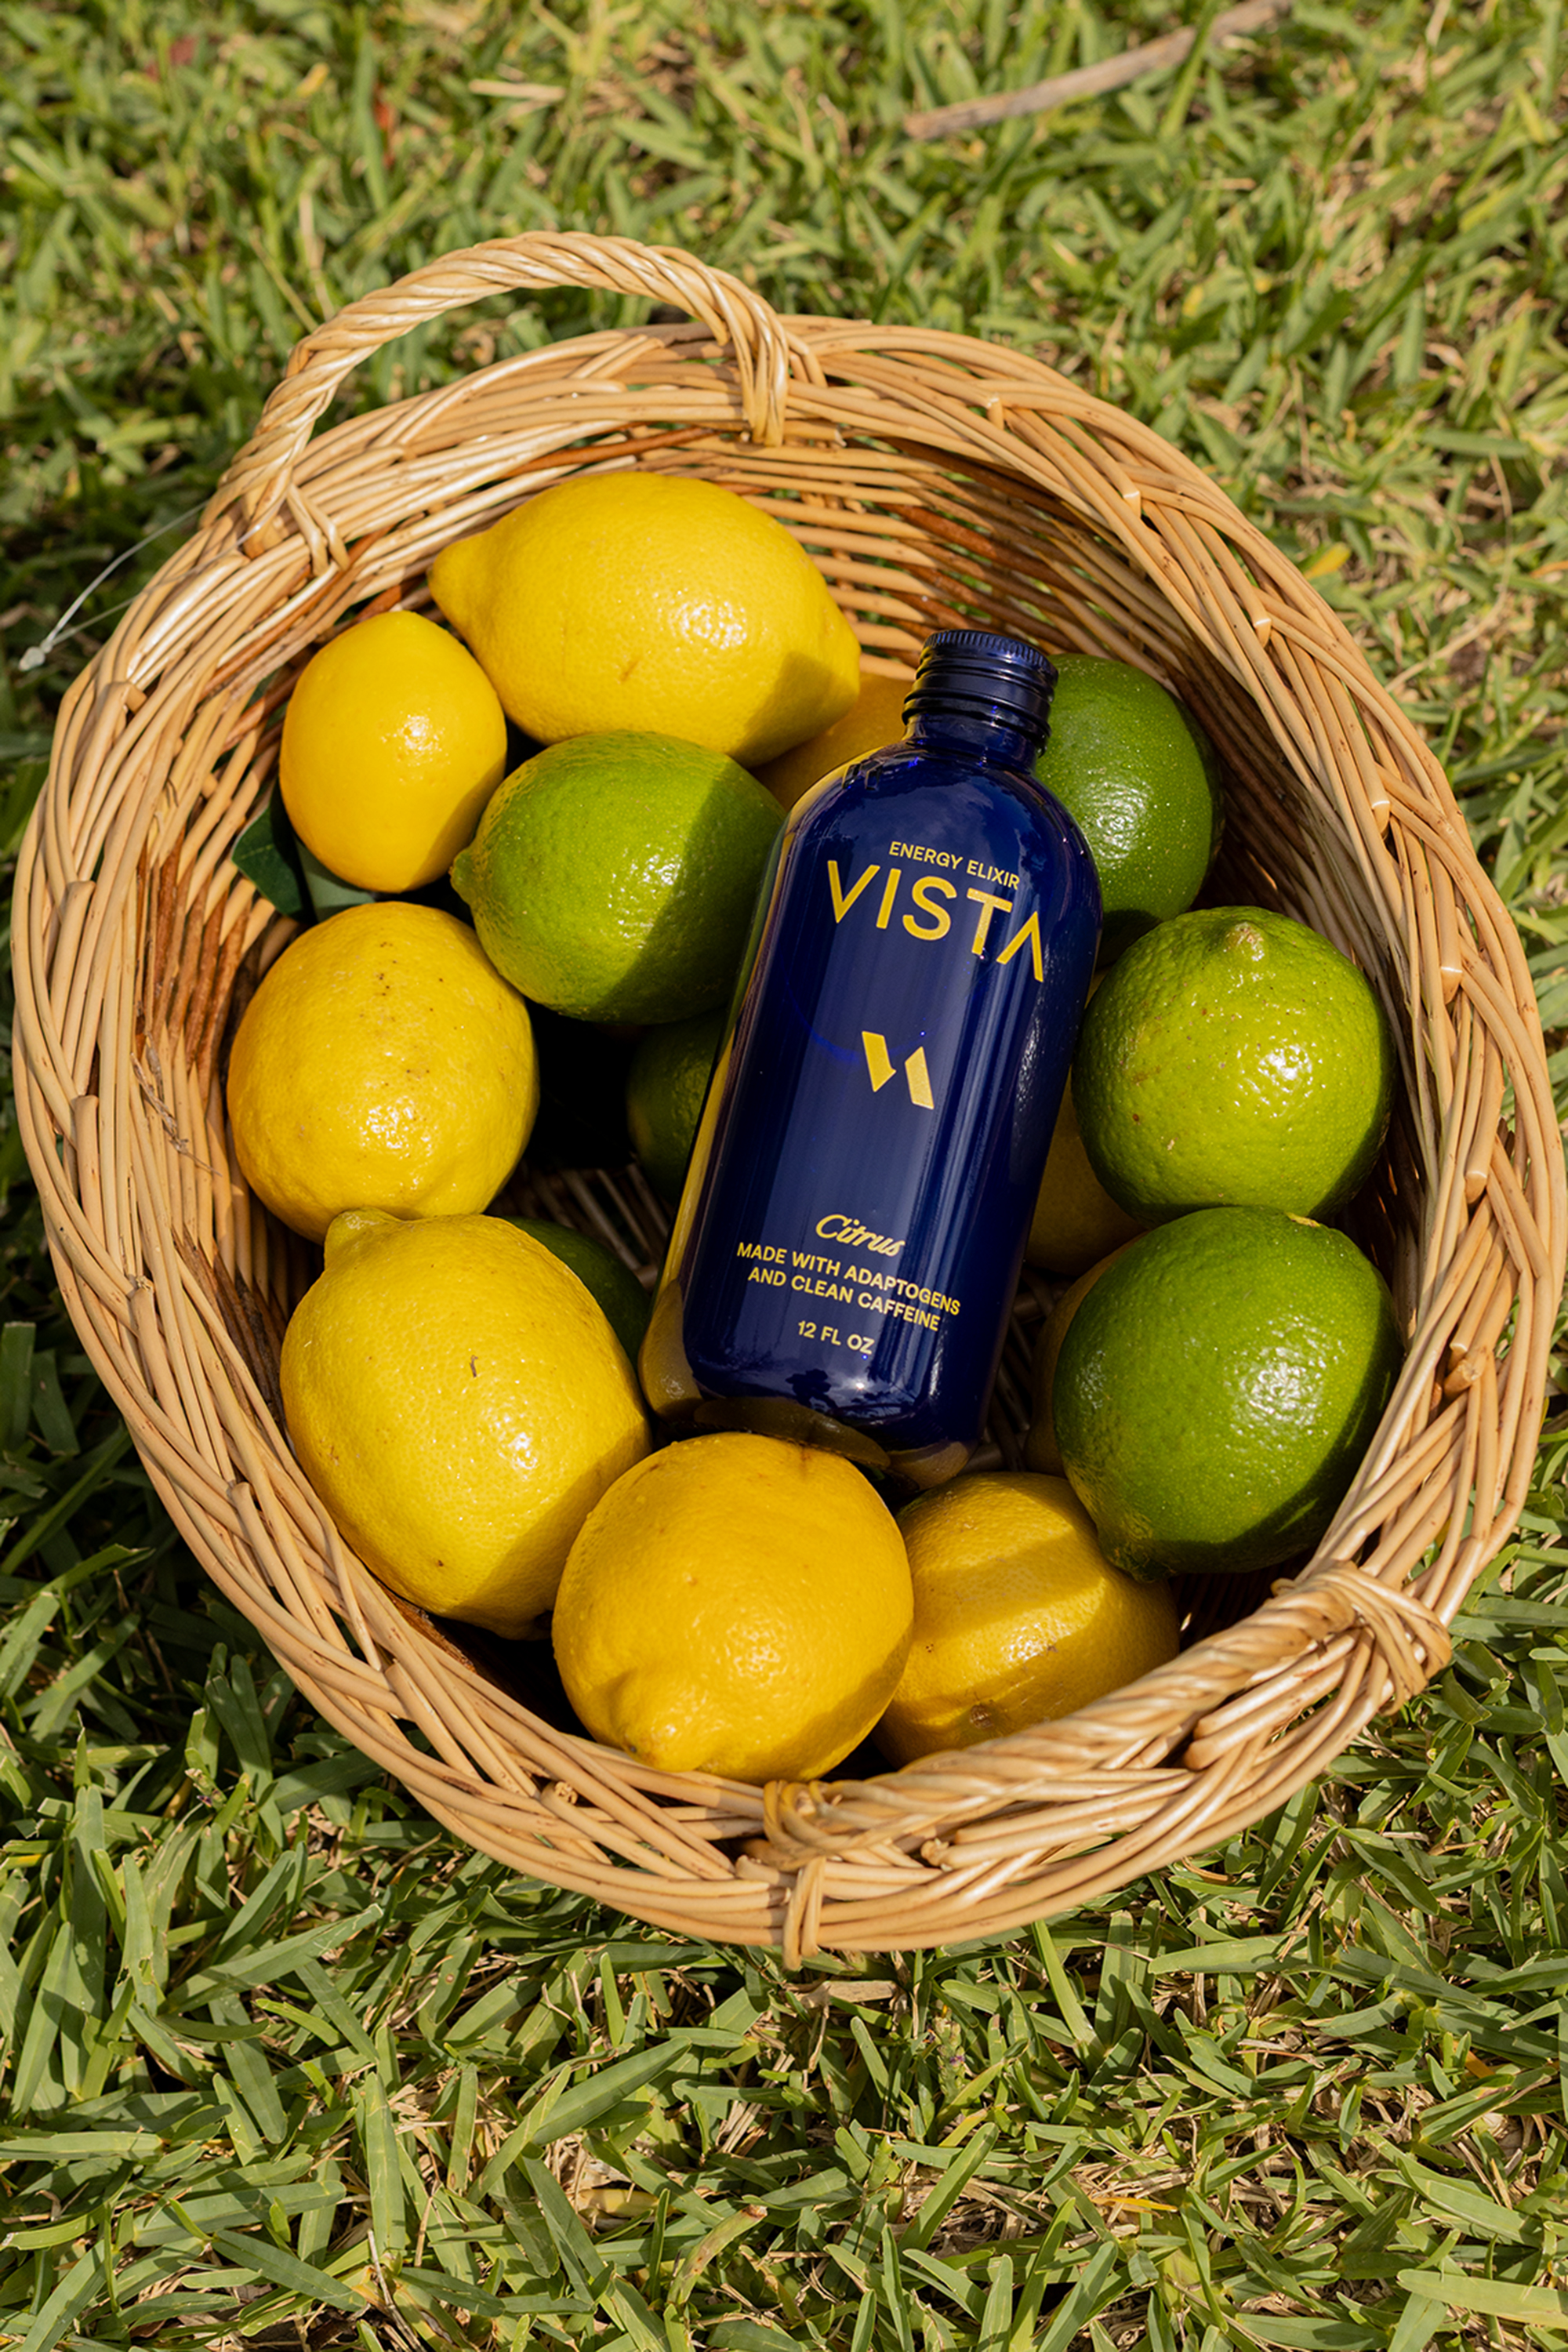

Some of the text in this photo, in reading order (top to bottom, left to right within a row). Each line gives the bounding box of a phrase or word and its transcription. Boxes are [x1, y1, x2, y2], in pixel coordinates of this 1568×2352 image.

[889, 841, 1020, 890] ENERGY ELIXIR
[827, 860, 1044, 982] VISTA
[815, 1214, 906, 1257] Citrus
[737, 1242, 961, 1316] MADE WITH ADAPTOGENS
[748, 1267, 940, 1332] AND CLEAN CAFFEINE
[797, 1320, 875, 1355] 12 FL OZ
